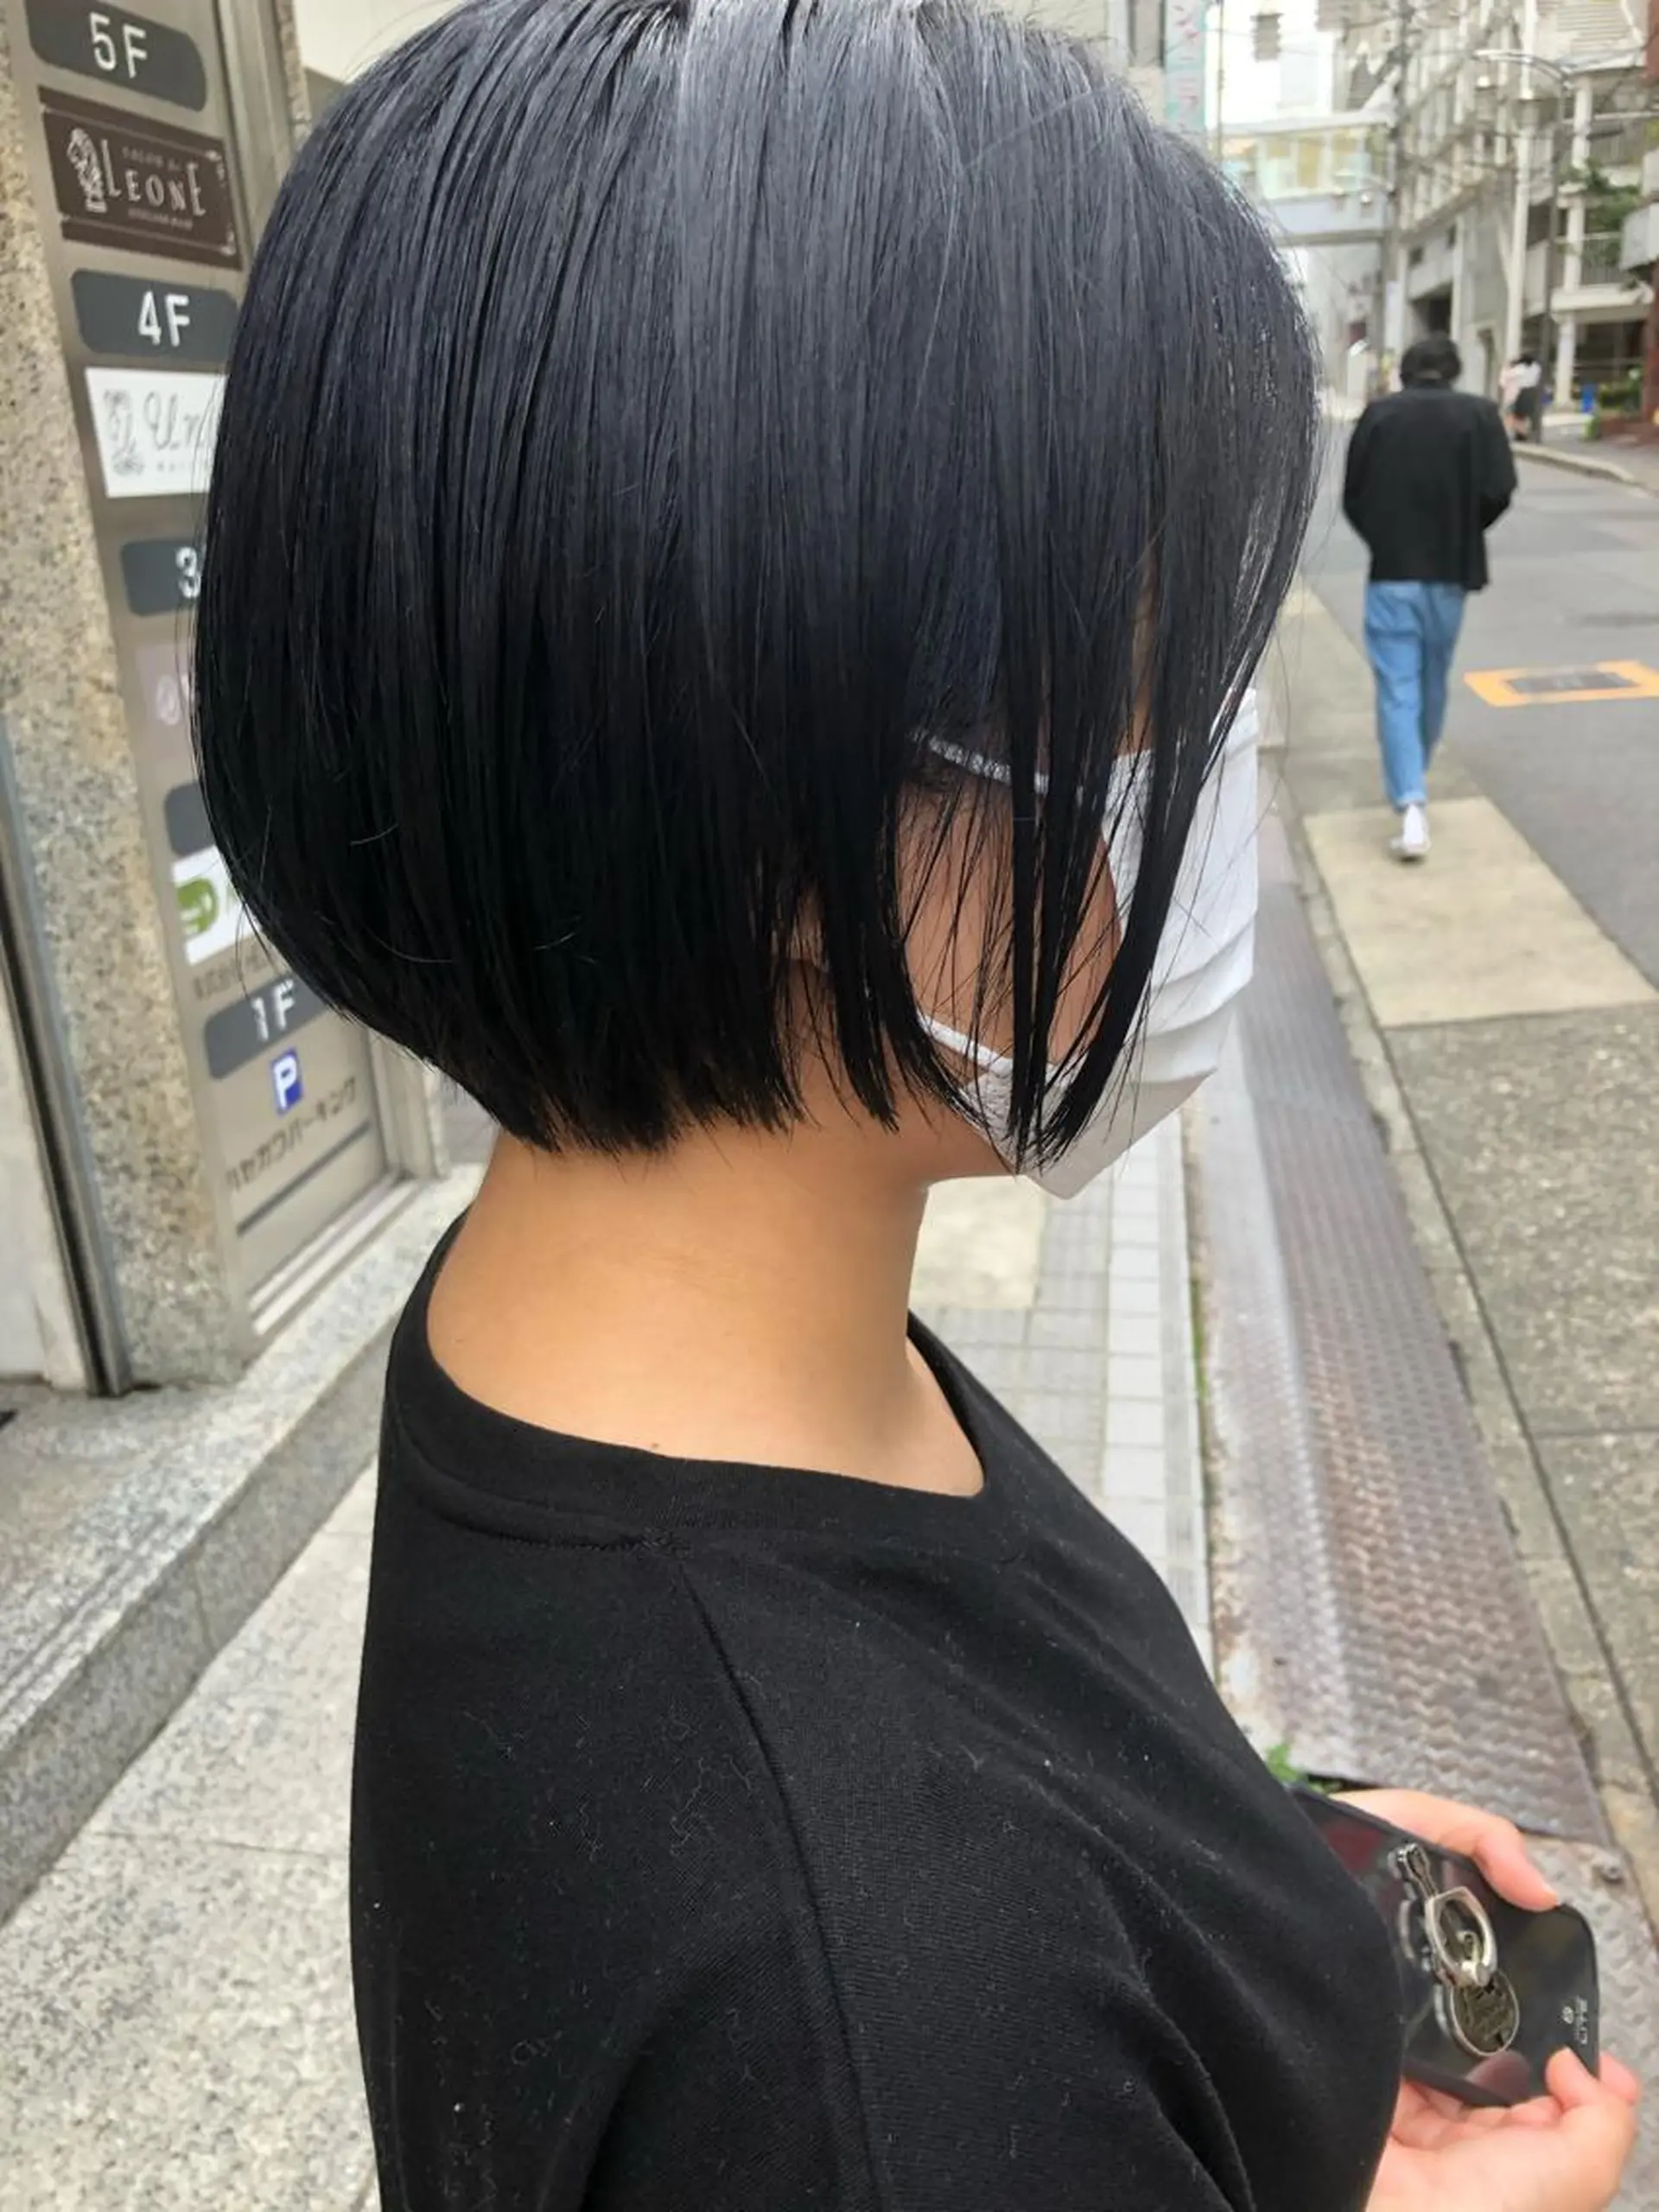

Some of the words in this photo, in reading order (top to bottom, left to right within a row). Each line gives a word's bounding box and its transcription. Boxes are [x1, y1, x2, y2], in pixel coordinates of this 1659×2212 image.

[89, 11, 148, 79] 5F
[100, 139, 207, 216] LEONE
[138, 290, 190, 347] 4F
[252, 979, 296, 1041] 1F
[273, 1054, 299, 1109] P
